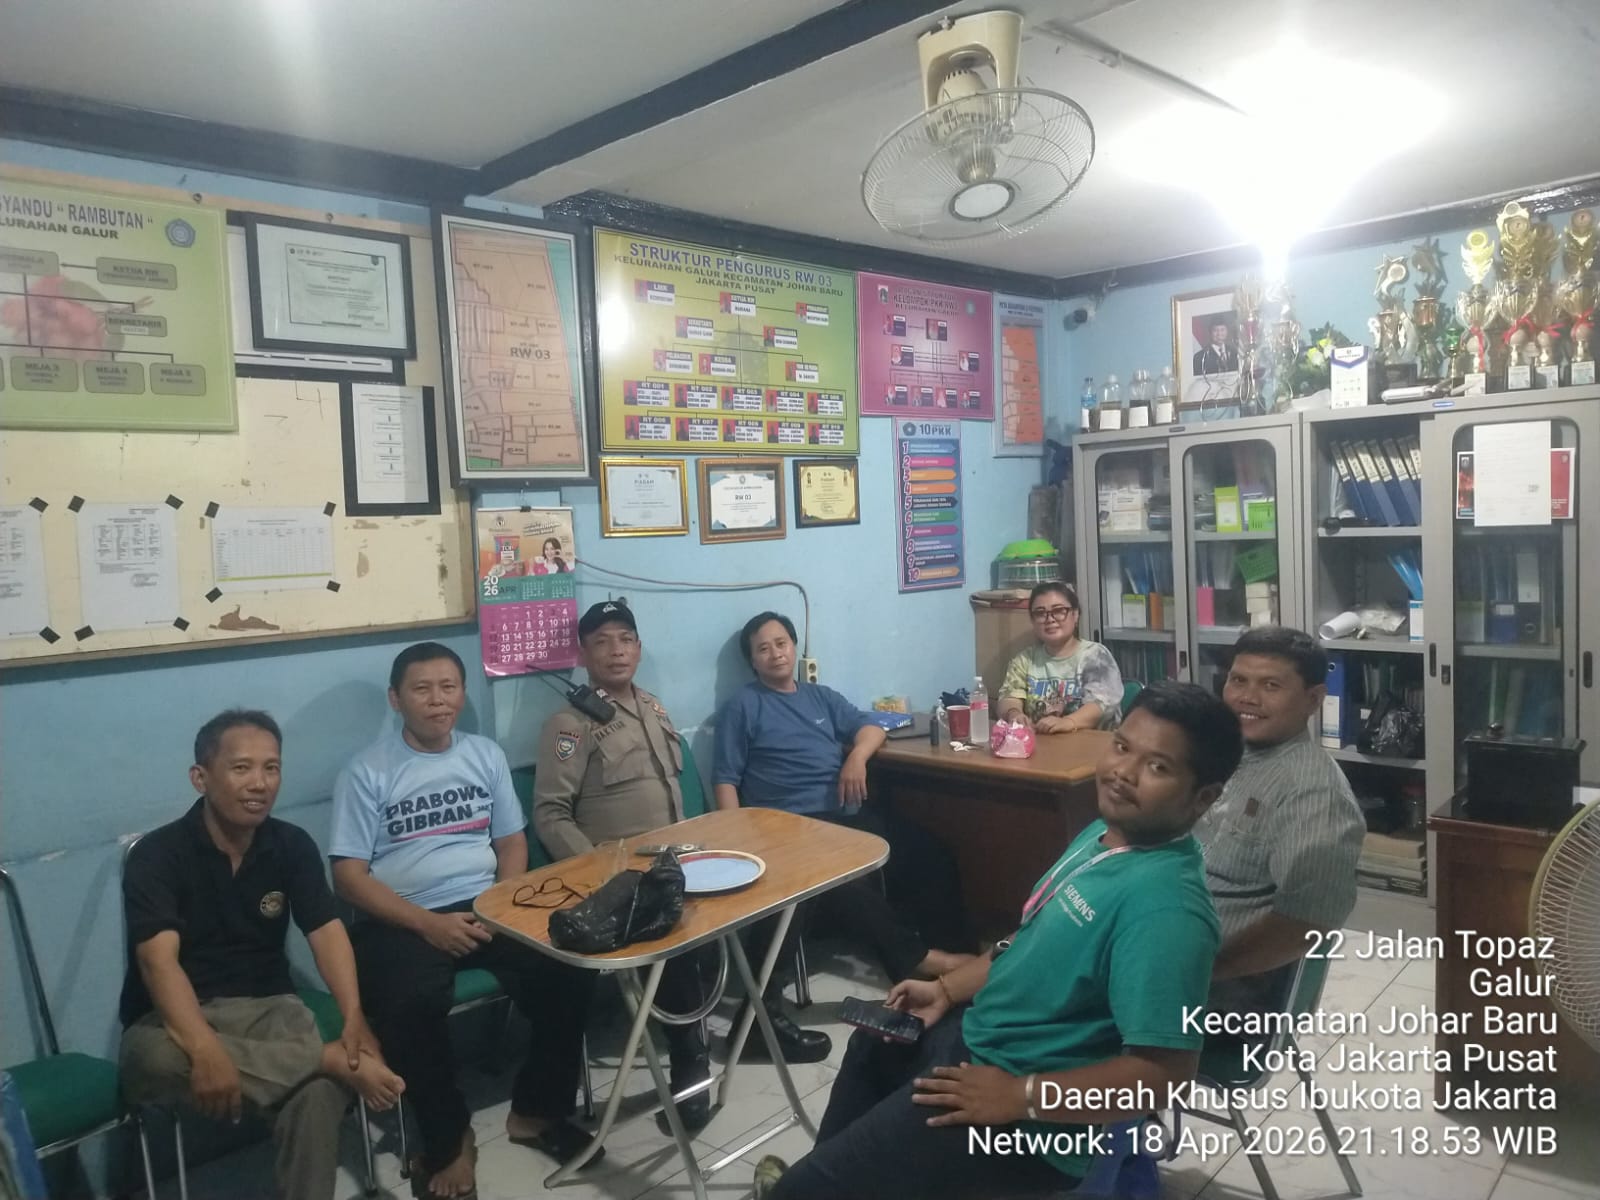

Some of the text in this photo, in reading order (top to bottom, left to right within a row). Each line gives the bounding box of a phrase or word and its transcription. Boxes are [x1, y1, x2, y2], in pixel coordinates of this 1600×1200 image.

[0, 195, 52, 218] YANDU
[68, 203, 143, 230] RAMBUTAN
[72, 225, 118, 239] GALUR
[630, 242, 832, 287] STRUKTUR PENGURUS RW 03
[614, 254, 843, 298] KELURAHAN GALUR KECAMATAN JOHAR BARU
[696, 276, 775, 295] JAKARTA PUSAT
[510, 347, 550, 360] RW 03
[920, 424, 951, 436] 10 PKK
[902, 441, 909, 454] 1
[903, 455, 911, 468] 2
[905, 496, 912, 509] 5
[905, 511, 912, 524] 6
[905, 525, 913, 538] 7
[906, 538, 914, 553] 8
[907, 554, 915, 568] 9
[484, 575, 499, 586] 20
[908, 567, 920, 582] 10
[484, 585, 499, 597] 26
[538, 610, 543, 618] 2
[562, 608, 568, 616] 4
[502, 623, 508, 631] 6
[514, 622, 519, 630] 7
[526, 620, 532, 629] 8
[550, 618, 559, 627] 10
[501, 633, 510, 642] 13
[513, 632, 522, 640] 14
[525, 631, 534, 639] 15
[538, 630, 547, 638] 16
[550, 628, 558, 636] 17
[501, 644, 510, 652] 20
[513, 642, 522, 651] 21
[525, 641, 535, 650] 22
[537, 640, 547, 648] 23
[502, 651, 547, 663] 27 28 29 30
[388, 804, 473, 836] GIBRAN
[1064, 884, 1096, 922] SIEMENS
